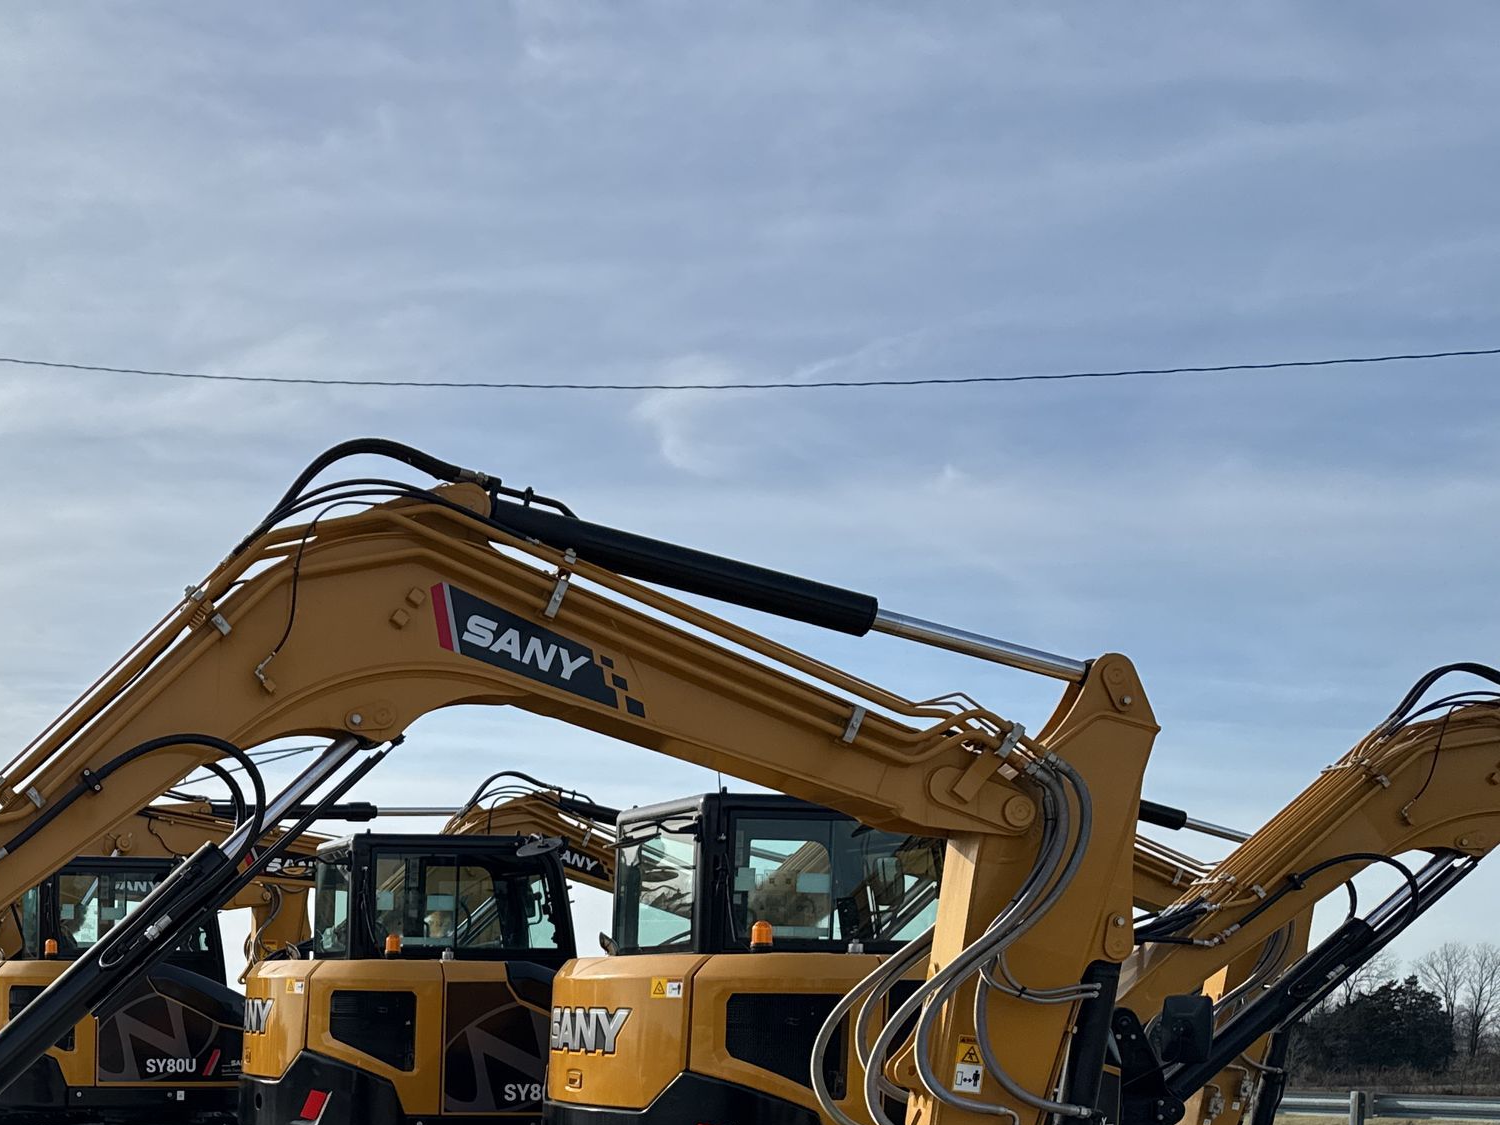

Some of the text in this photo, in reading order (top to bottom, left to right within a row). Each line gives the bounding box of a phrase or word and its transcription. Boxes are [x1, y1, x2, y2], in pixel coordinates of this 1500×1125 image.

[462, 613, 590, 681] SANY
[560, 849, 599, 872] ANY
[145, 1058, 197, 1073] SY80U
[504, 1083, 545, 1101] SY8
